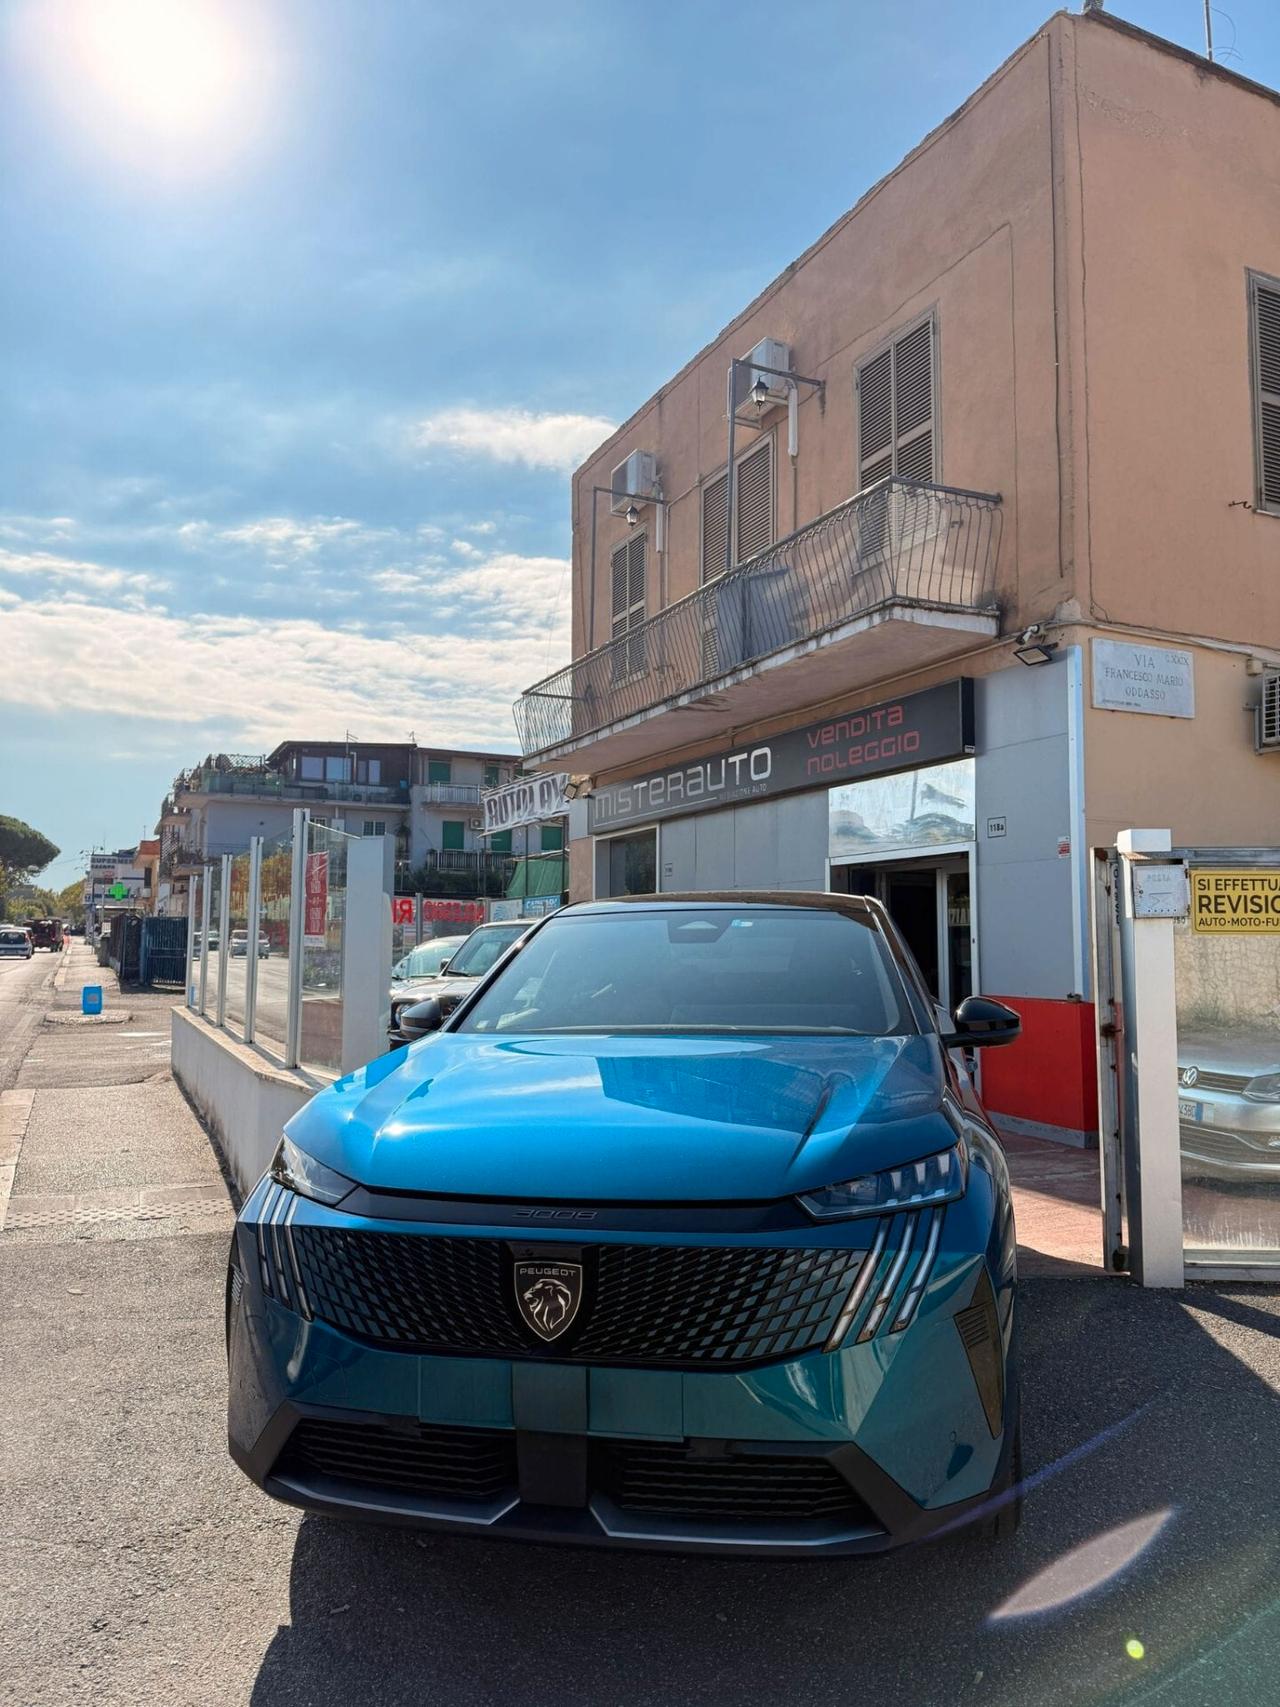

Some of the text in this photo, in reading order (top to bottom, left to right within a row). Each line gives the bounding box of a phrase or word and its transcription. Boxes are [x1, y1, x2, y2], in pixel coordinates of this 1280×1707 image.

[1134, 654, 1155, 669] VIA
[1105, 667, 1153, 683] FRANCESCO
[1125, 686, 1166, 700] ODDASSO
[1197, 878, 1210, 891] SI
[1215, 878, 1280, 891] EFFETTU
[512, 1208, 598, 1220] 3008
[519, 1267, 576, 1277] PEUGEOT
